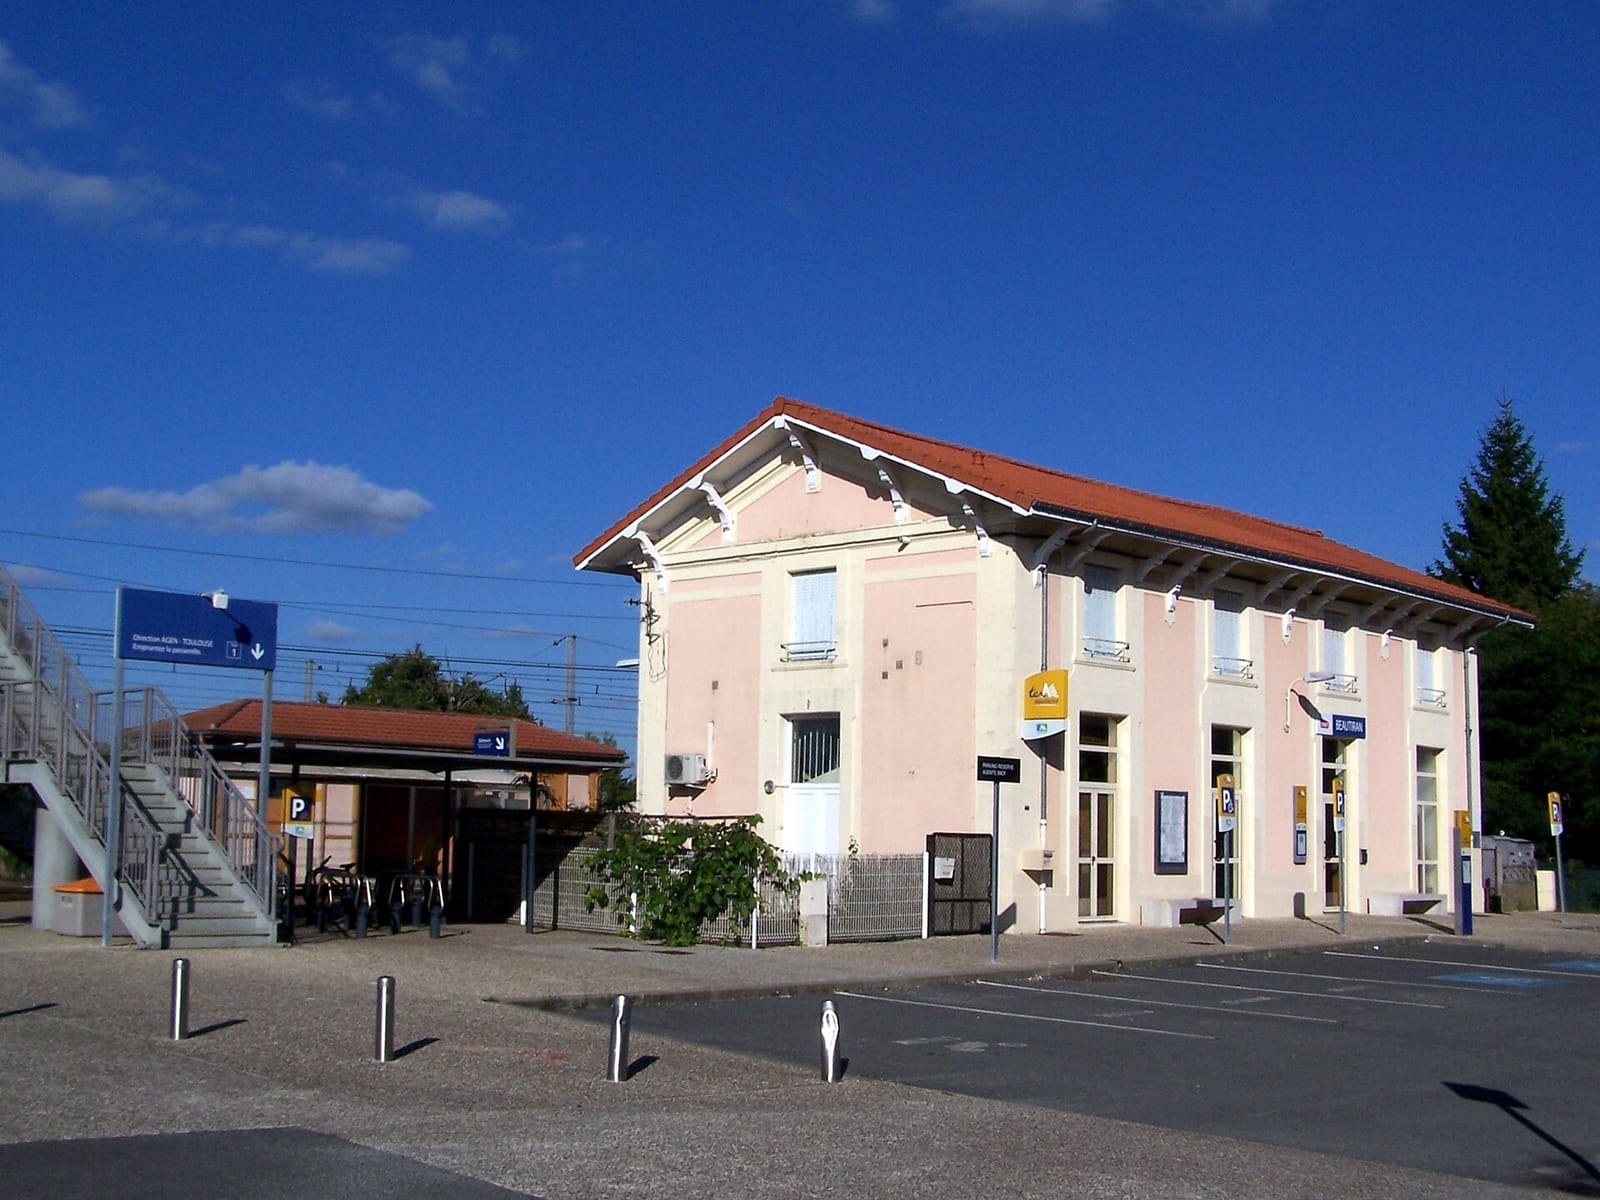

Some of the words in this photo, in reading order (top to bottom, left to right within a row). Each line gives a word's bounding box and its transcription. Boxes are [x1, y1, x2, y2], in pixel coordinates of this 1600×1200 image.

[133, 634, 159, 642] Direction
[160, 635, 178, 644] AGEN
[182, 637, 213, 647] TOULOUSE
[231, 648, 237, 657] 1
[292, 798, 305, 818] P
[1223, 790, 1231, 811] P
[1337, 792, 1343, 814] P
